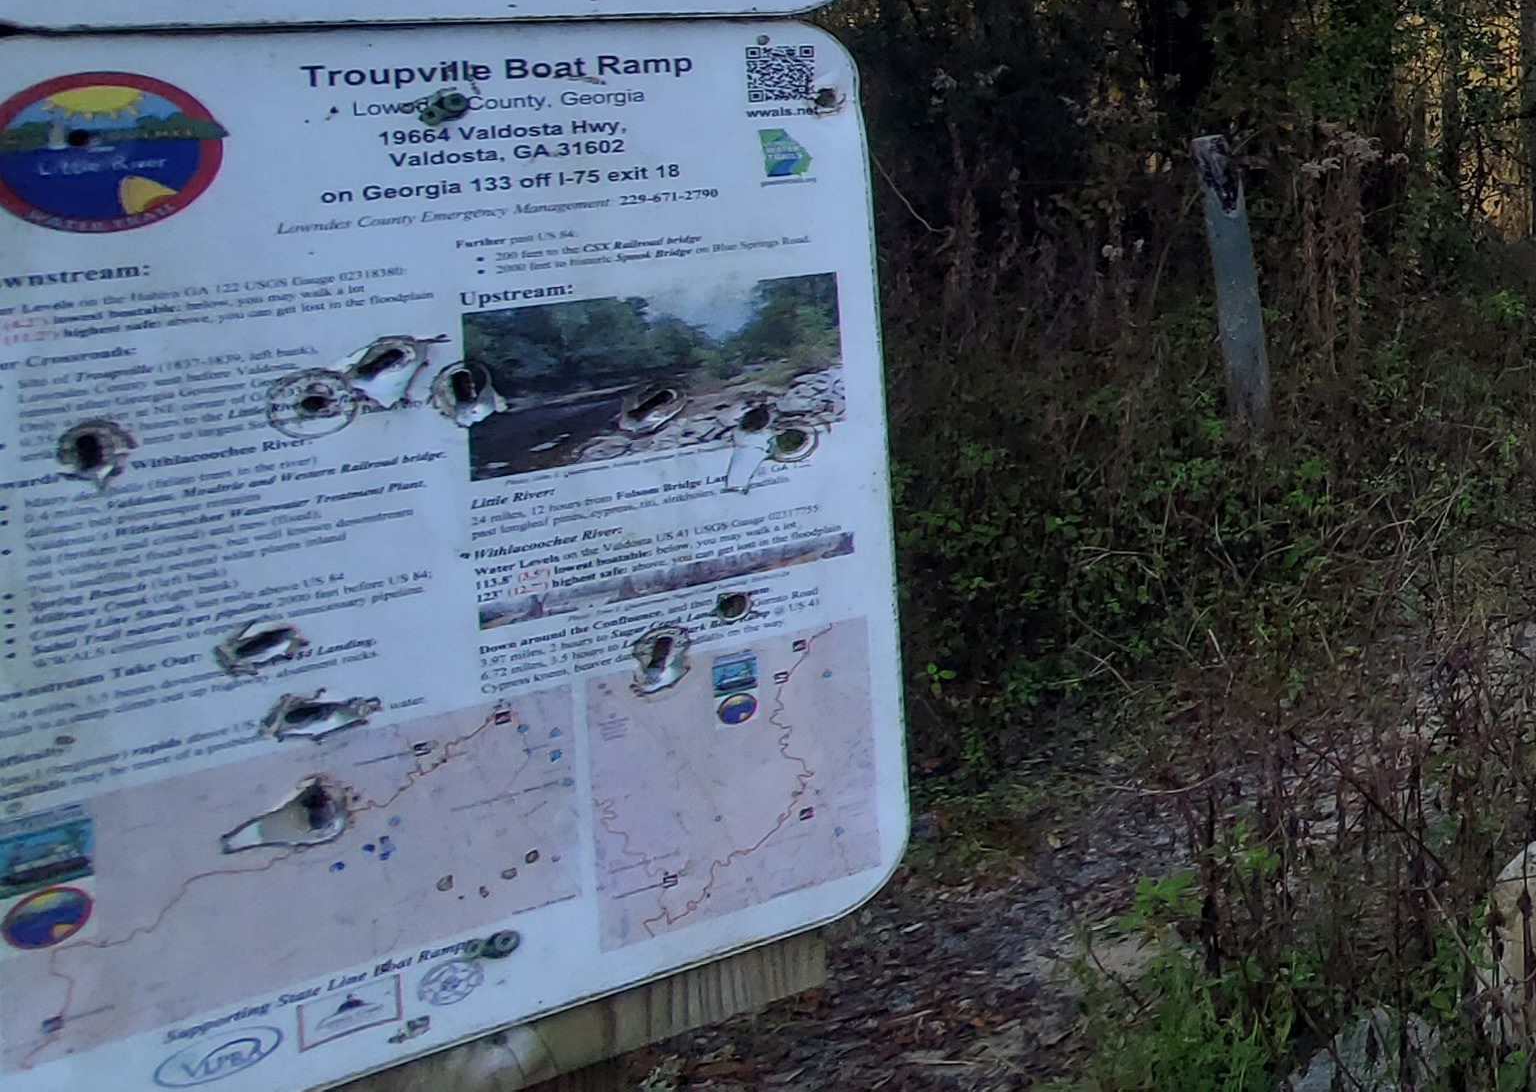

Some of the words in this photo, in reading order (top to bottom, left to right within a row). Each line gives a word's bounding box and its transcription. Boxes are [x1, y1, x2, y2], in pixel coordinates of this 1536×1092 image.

[300, 60, 492, 89] Troupville
[505, 56, 586, 79] Boat
[597, 54, 693, 78] Ramp
[560, 89, 645, 107] Georgia
[377, 127, 451, 146] 19664
[458, 122, 563, 141] Valdosta
[570, 119, 627, 135] Hwy,
[389, 147, 506, 168] Valdosta,
[513, 144, 549, 160] GA
[557, 139, 626, 157] 31602
[320, 189, 354, 204] on
[363, 179, 462, 200] Georgia
[470, 175, 512, 193] 133
[519, 172, 552, 190] off
[558, 169, 600, 187] I-75
[607, 165, 649, 183] exit
[655, 164, 681, 179] 18
[276, 219, 351, 236] Lowndes
[356, 213, 417, 229] County
[420, 206, 507, 225] Emergency
[618, 188, 719, 206] 229-671-2790
[582, 242, 611, 253] CSX
[0, 262, 151, 290] wnstream:
[459, 281, 575, 308] Upstream:
[662, 479, 703, 494] Bridge
[474, 535, 579, 560] Withlacoochee
[474, 563, 516, 577] Water
[518, 555, 560, 570] Levels
[277, 984, 322, 1008] State
[327, 970, 368, 992] Line
